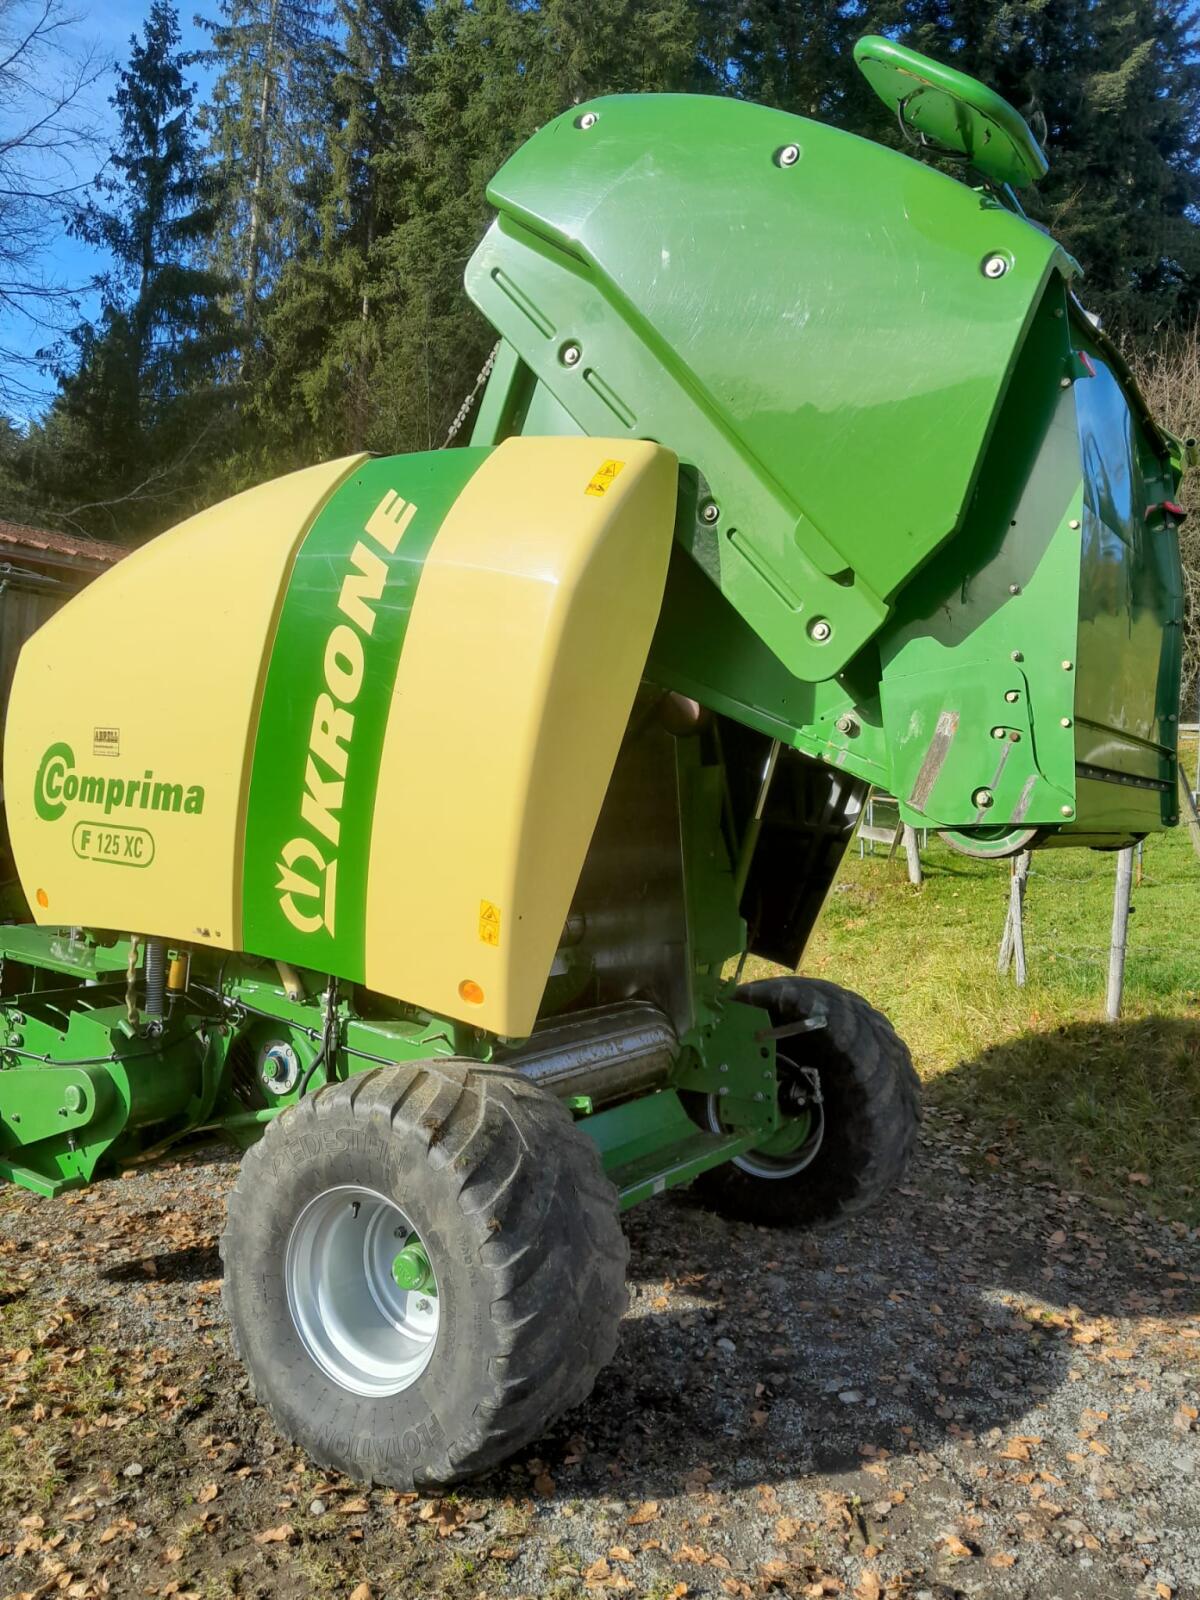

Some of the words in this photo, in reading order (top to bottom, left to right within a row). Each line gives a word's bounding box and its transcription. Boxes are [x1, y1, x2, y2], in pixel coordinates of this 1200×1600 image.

[300, 488, 418, 847] KRONE
[34, 742, 205, 821] Comprima
[81, 830, 91, 850] F
[97, 833, 120, 855] 125
[124, 835, 144, 858] XC
